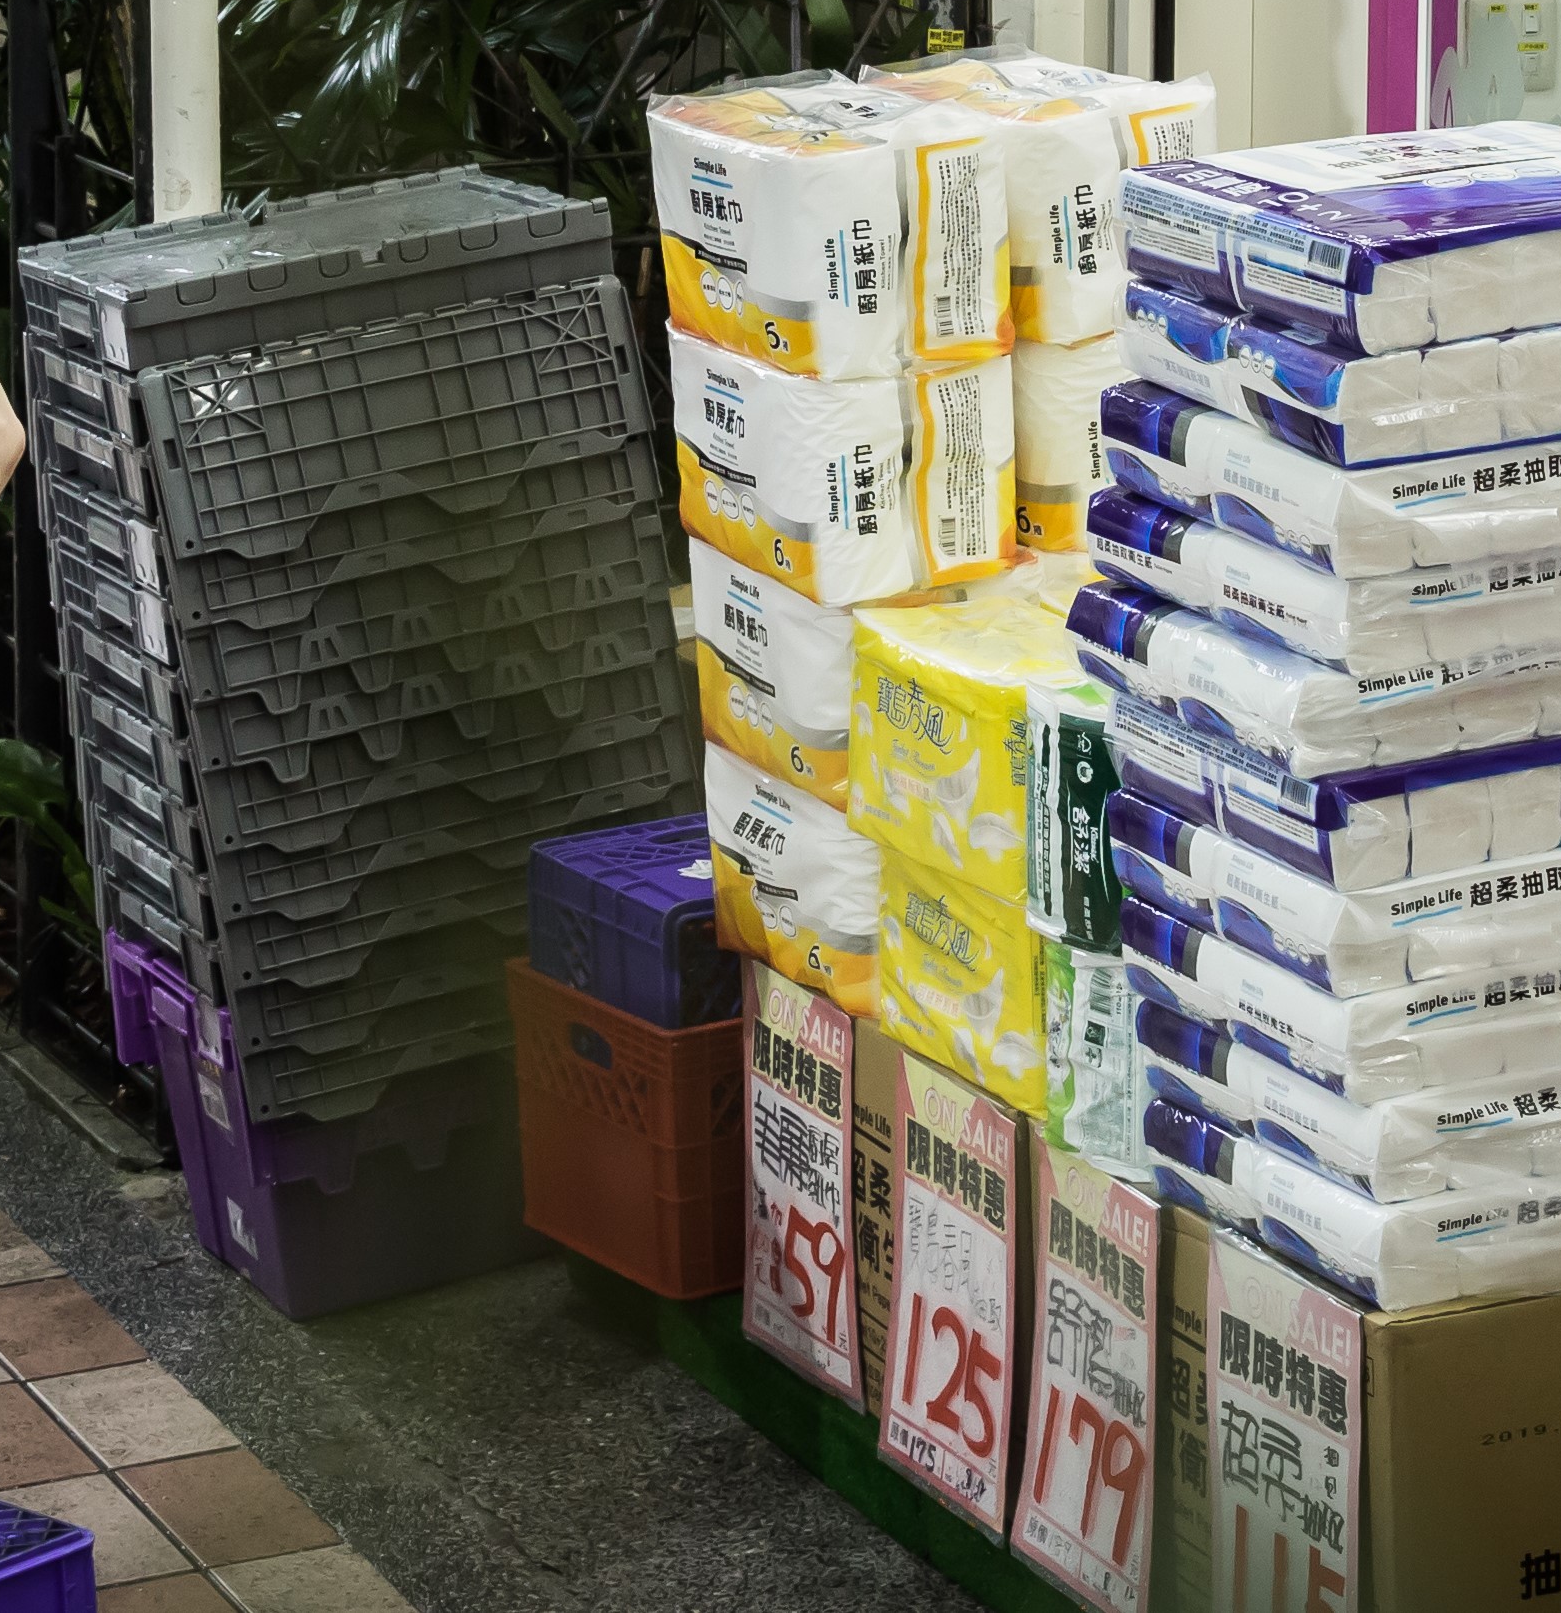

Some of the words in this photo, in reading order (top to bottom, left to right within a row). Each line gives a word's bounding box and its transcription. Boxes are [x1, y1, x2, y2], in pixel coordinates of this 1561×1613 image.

[693, 156, 713, 175] Simple
[714, 160, 727, 176] Life
[690, 188, 742, 225] 廚房紙巾
[1051, 204, 1060, 222] Life
[828, 238, 838, 257] Life
[1053, 224, 1064, 264] Simple
[1069, 184, 1096, 276] 廚房紙巾
[828, 258, 839, 300] Simple
[848, 219, 877, 314] 廚房紙巾
[706, 368, 725, 386] Simple
[726, 377, 739, 392] Life
[704, 399, 745, 440] 廚房紙巾
[1089, 421, 1098, 439] Life
[828, 462, 837, 480] Life
[1090, 440, 1102, 479] Simple
[828, 481, 839, 523] Simple
[846, 445, 877, 536] 廚房紙巾
[1392, 480, 1438, 499] Simple
[1442, 474, 1465, 489] Life
[723, 603, 768, 648] 廚房紙巾
[1358, 674, 1406, 693] Simple
[1410, 668, 1434, 683] Life
[754, 784, 778, 804] Simple
[779, 795, 792, 812] Life
[735, 812, 786, 859] 廚房紙巾
[1391, 896, 1436, 916] Simple
[1438, 888, 1463, 905] Life
[768, 990, 796, 1033] ON
[800, 1007, 844, 1062] SALE!
[1406, 995, 1448, 1016] Simple
[753, 1017, 843, 1121] 限時特惠
[924, 1087, 956, 1139] ON
[961, 1108, 1008, 1171] SALE!
[1437, 1109, 1485, 1126] Simple
[1487, 1102, 1509, 1117] Life
[906, 1118, 1005, 1232] 限時特惠
[1067, 1168, 1096, 1212] ON
[1101, 1191, 1150, 1257] SALE!
[1437, 1214, 1482, 1233] Simple
[785, 1204, 845, 1345] 59
[1049, 1197, 1145, 1320] 限時特惠
[1289, 1300, 1351, 1368] SALE!
[902, 1292, 1000, 1457] 125
[1220, 1310, 1347, 1435] 限時特惠
[909, 1430, 936, 1472] 175
[1034, 1384, 1145, 1566] 179
